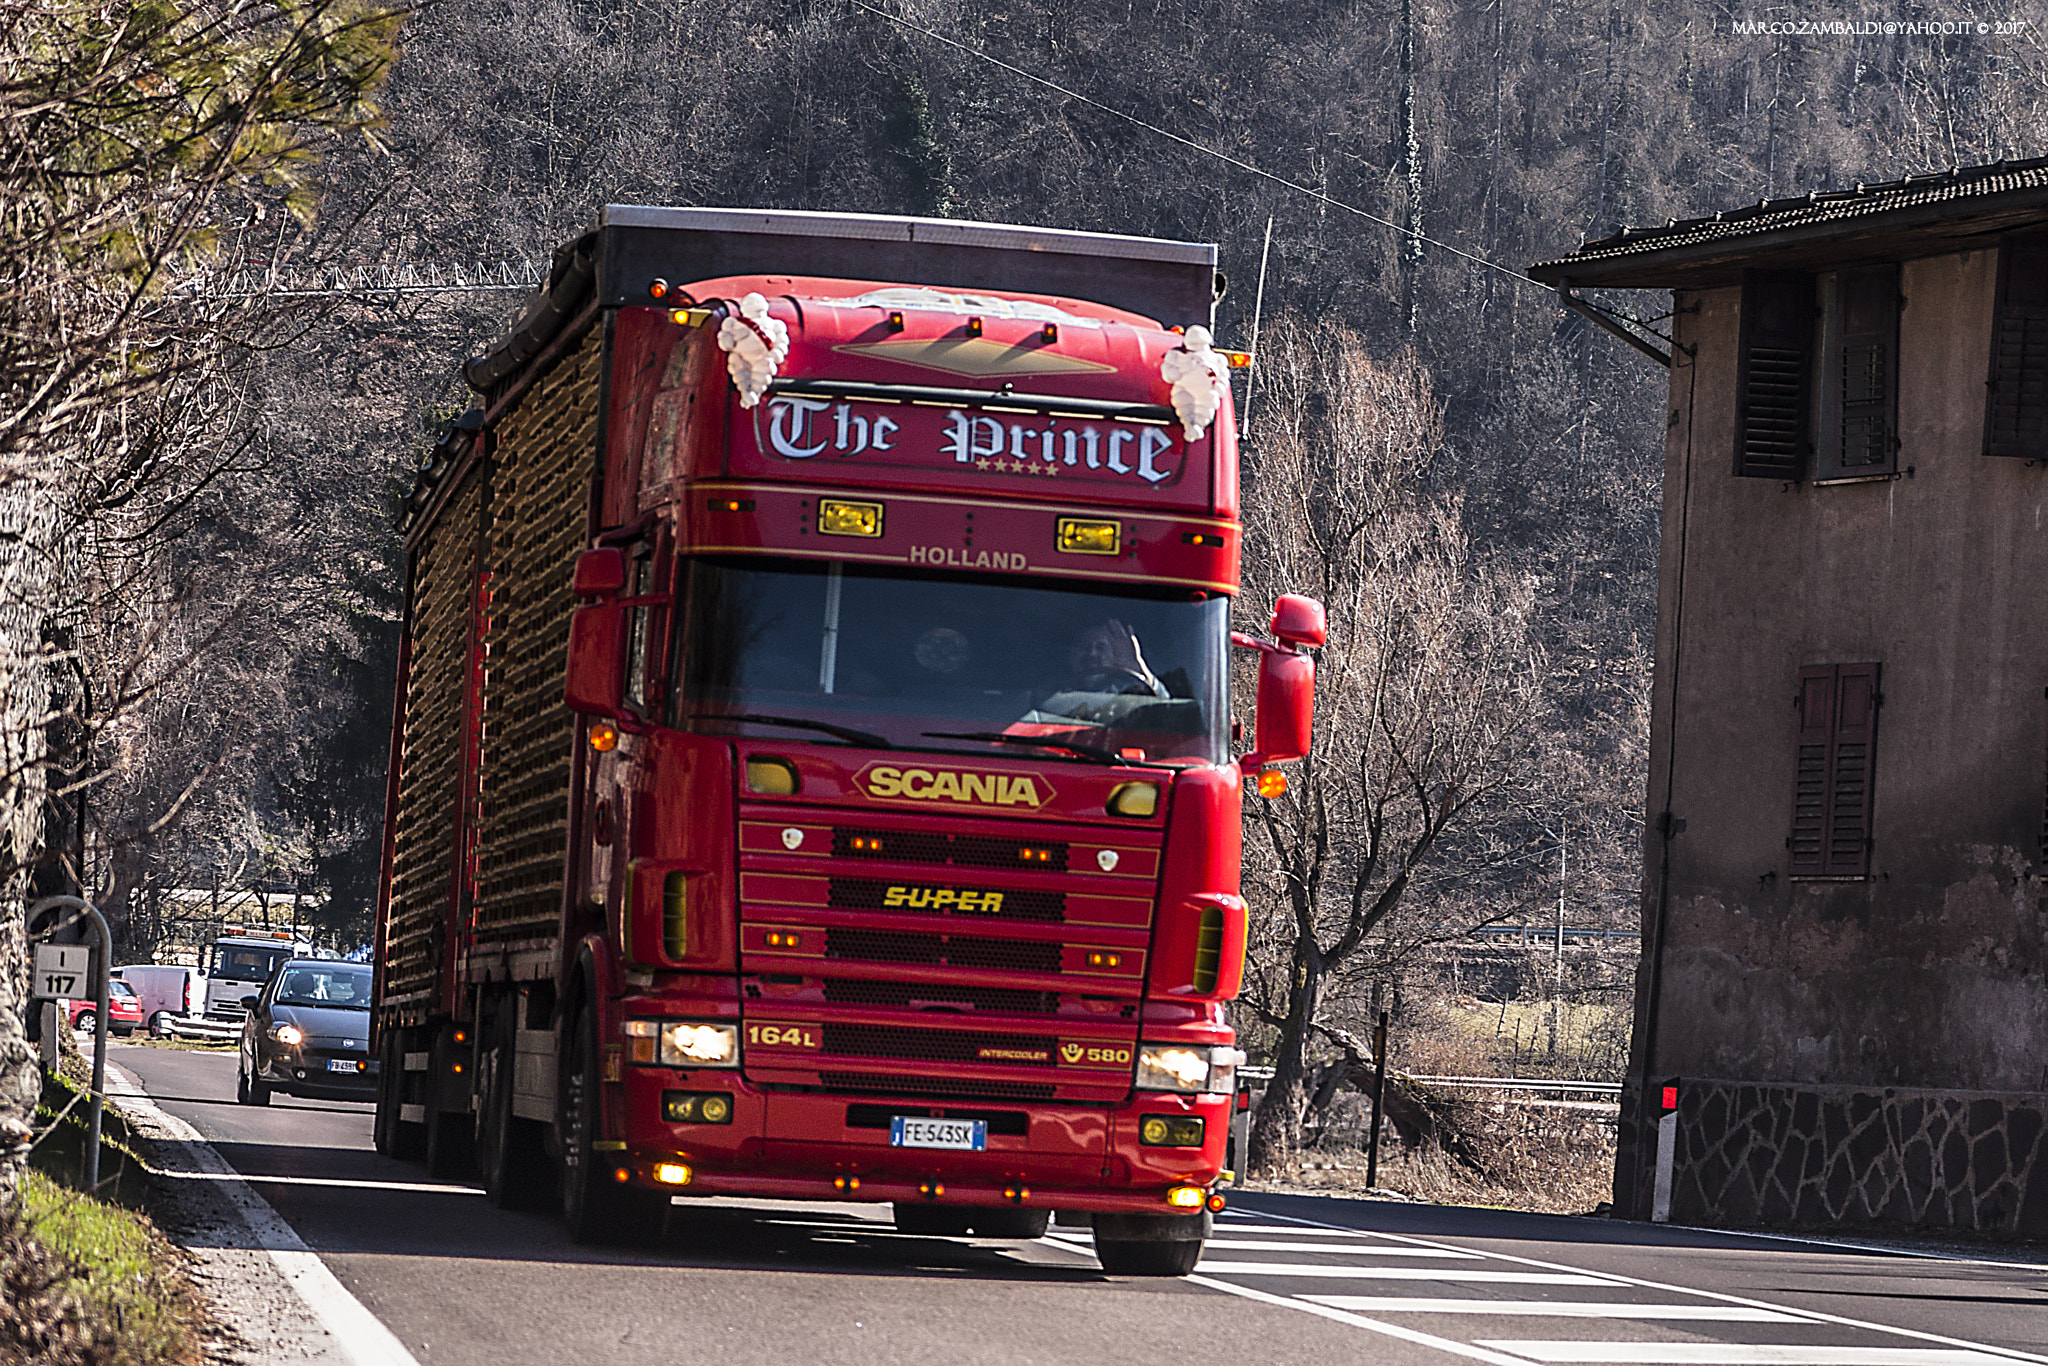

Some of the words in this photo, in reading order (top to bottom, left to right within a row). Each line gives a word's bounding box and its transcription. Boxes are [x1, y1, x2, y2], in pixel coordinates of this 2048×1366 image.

[768, 397, 900, 459] The
[938, 410, 1174, 483] Prince
[909, 545, 1027, 571] HOLLAND
[868, 766, 1040, 806] SCANIA
[883, 886, 1004, 912] SUPER
[46, 975, 76, 994] 117
[979, 1049, 1048, 1060] INTERCOOLER
[1087, 1048, 1130, 1063] 580
